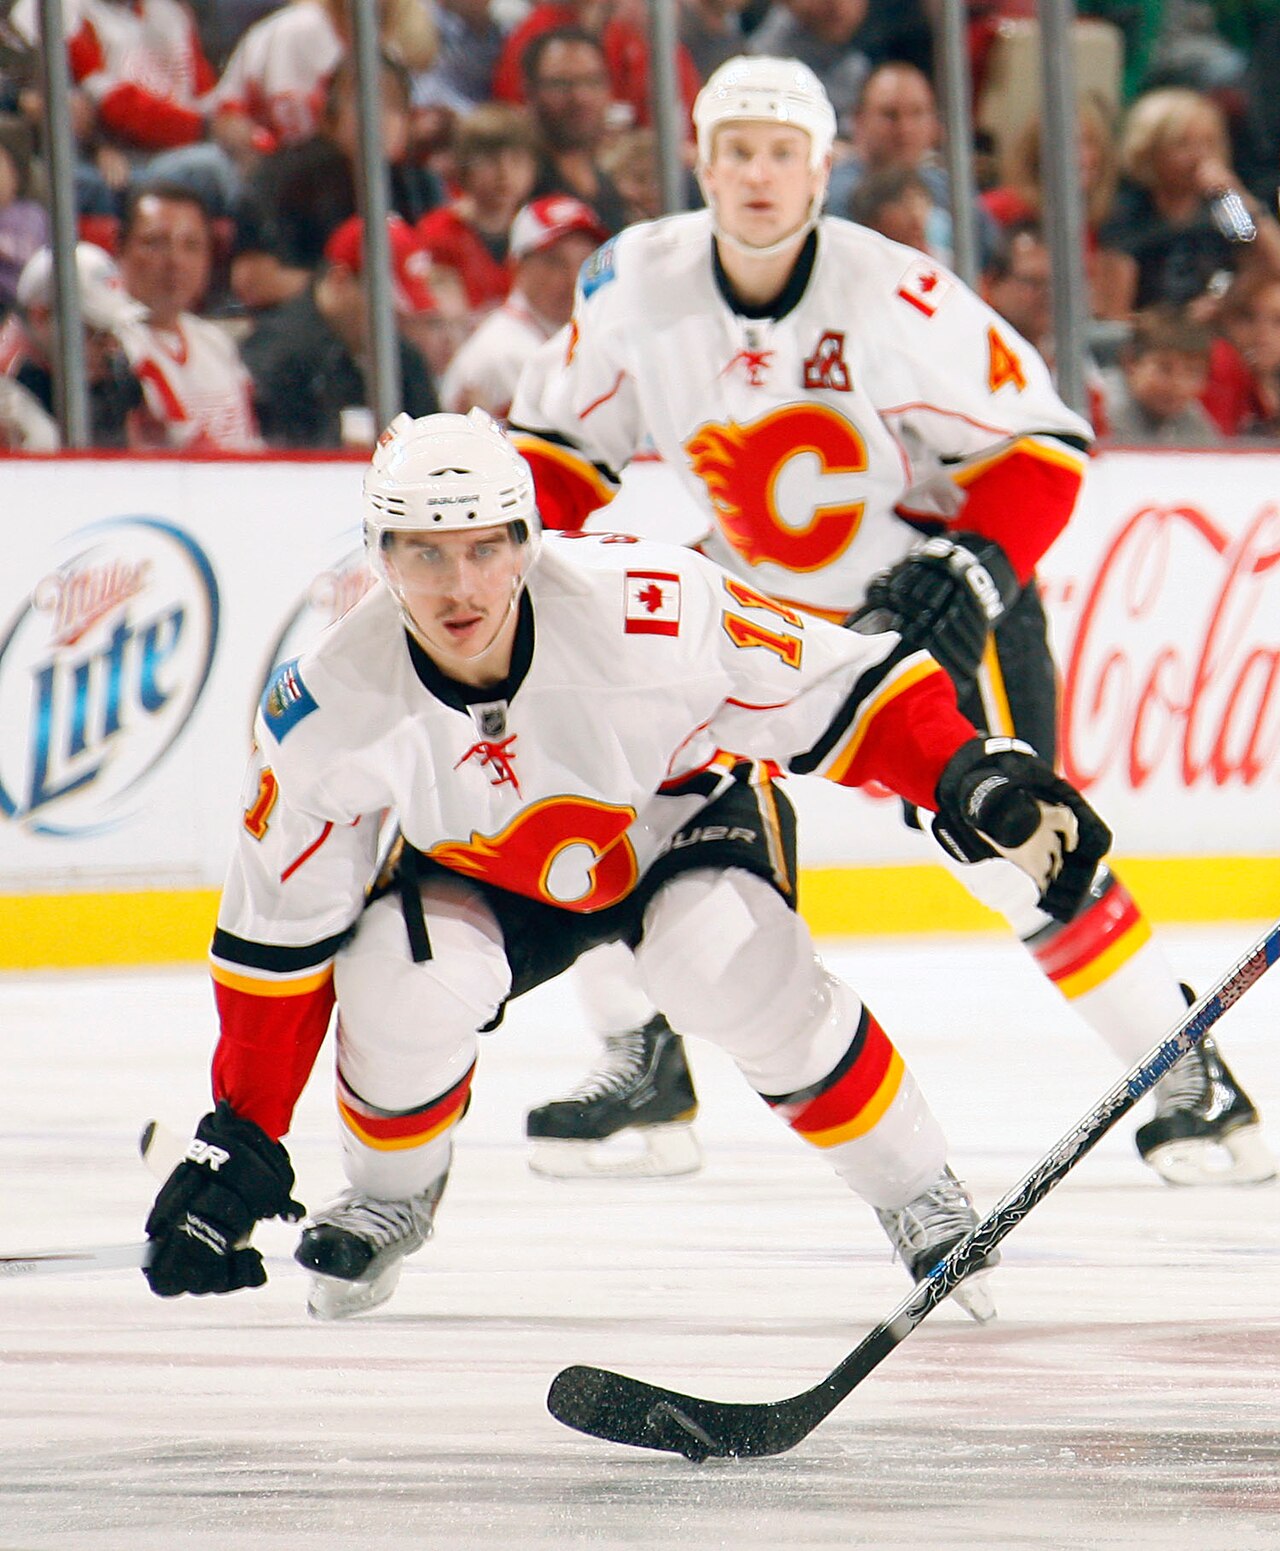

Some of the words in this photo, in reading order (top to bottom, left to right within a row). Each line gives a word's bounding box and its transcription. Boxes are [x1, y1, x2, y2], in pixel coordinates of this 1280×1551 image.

[802, 329, 853, 391] A
[987, 326, 1027, 393] 4
[722, 576, 804, 671] 11
[15, 600, 186, 818] Lite
